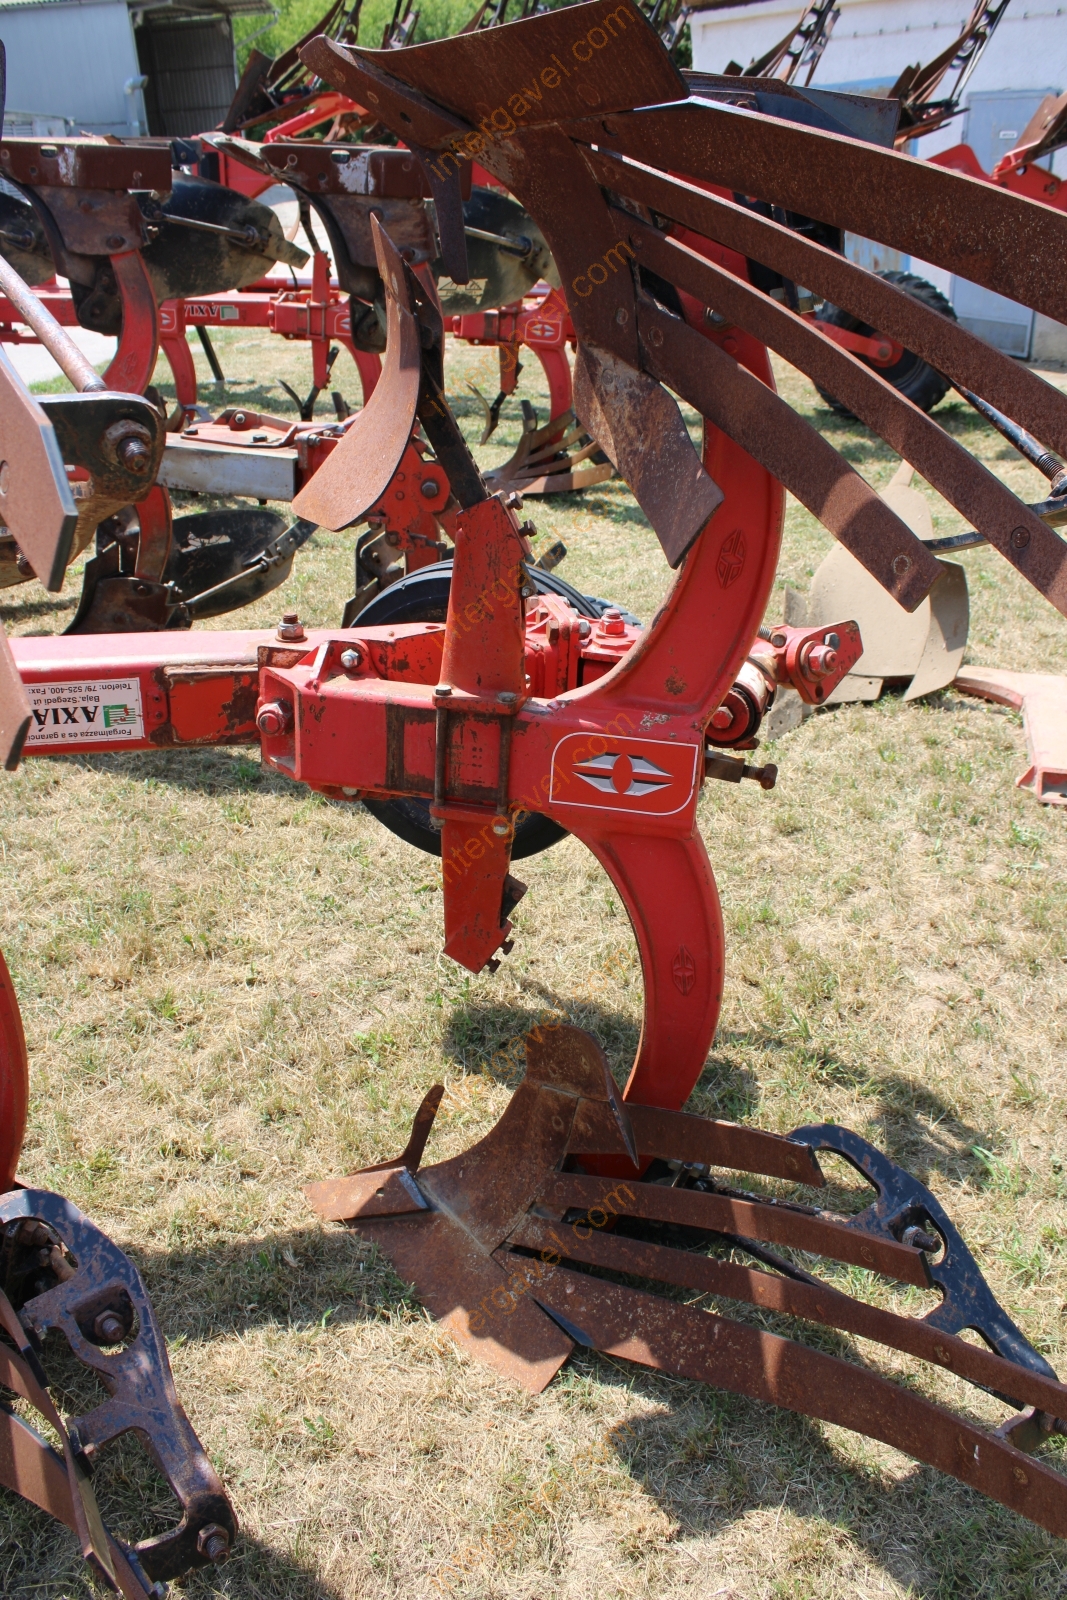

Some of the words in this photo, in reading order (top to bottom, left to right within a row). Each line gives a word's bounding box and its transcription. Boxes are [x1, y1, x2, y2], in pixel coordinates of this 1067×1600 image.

[99, 683, 132, 691] Telefon:
[33, 698, 42, 706] út
[44, 696, 78, 706] Szegedi
[32, 705, 99, 732] AXIÁ
[80, 728, 132, 739] Forgalmazza
